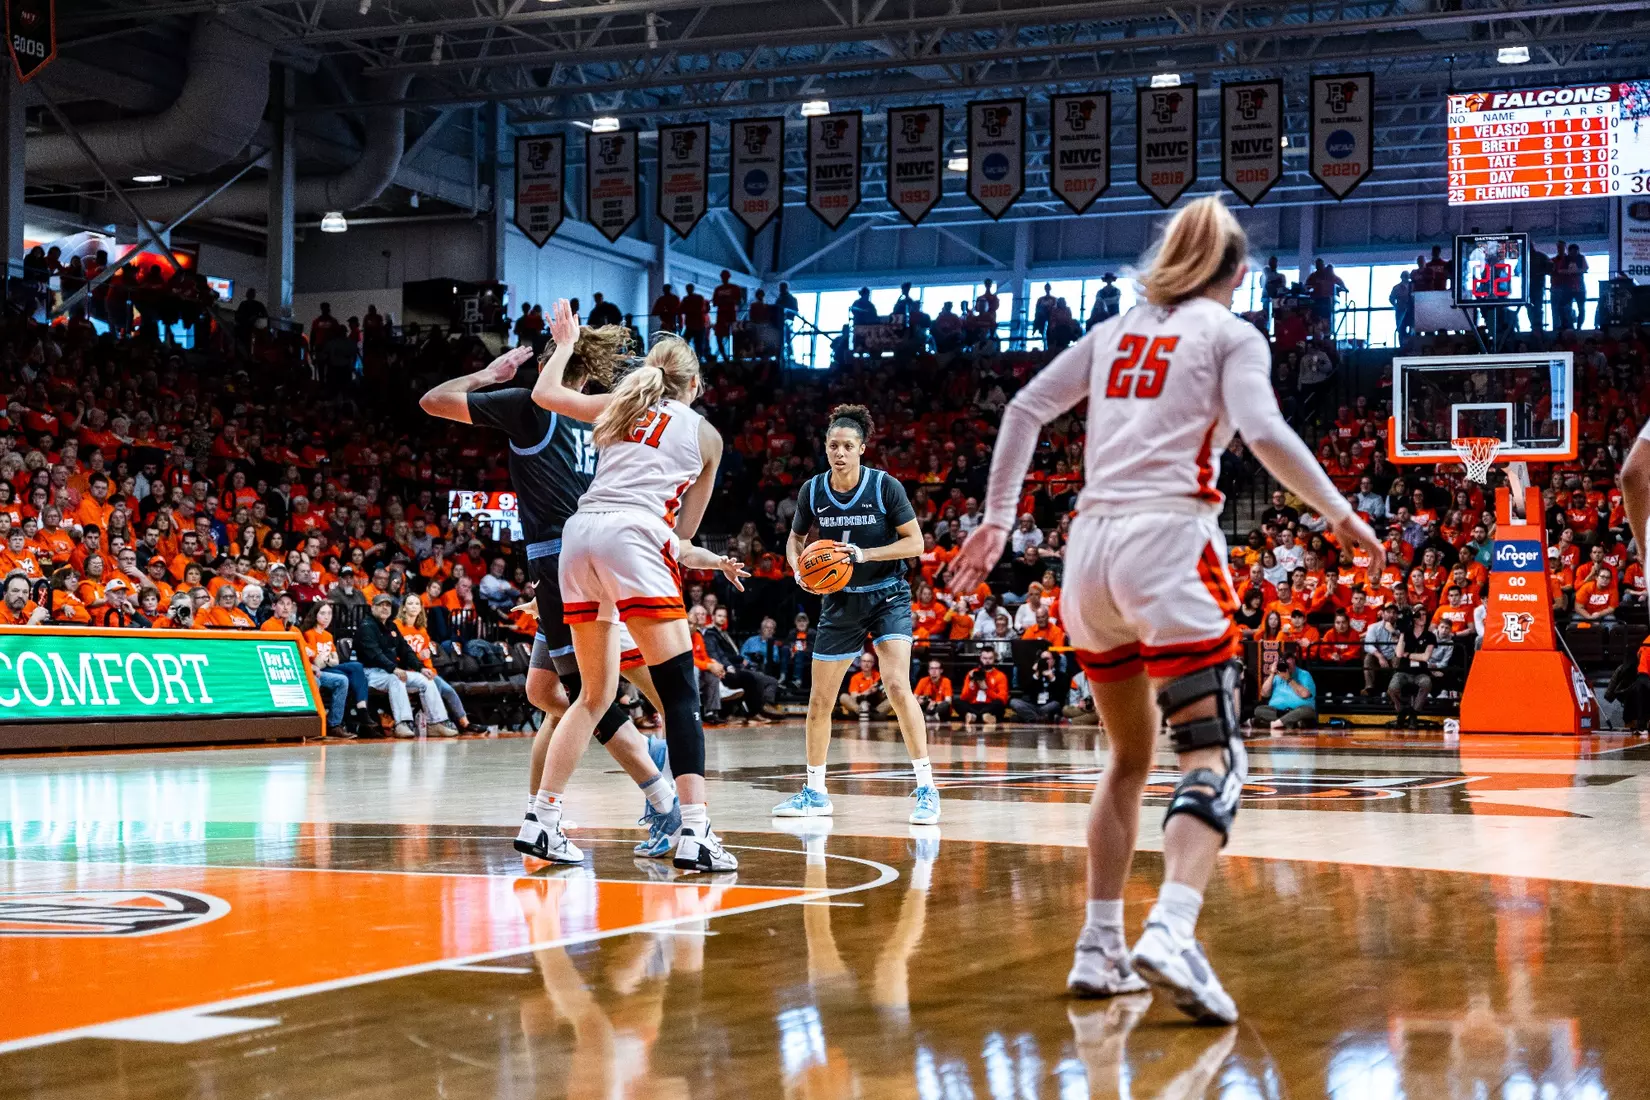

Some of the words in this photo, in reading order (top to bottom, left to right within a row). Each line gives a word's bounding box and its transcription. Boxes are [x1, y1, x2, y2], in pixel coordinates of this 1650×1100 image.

[14, 34, 44, 58] 2009
[1492, 86, 1612, 108] FALCONS
[1483, 112, 1516, 122] NAME
[1454, 127, 1460, 138] 1
[1474, 124, 1529, 138] VELASCO
[1542, 122, 1555, 133] 11
[1566, 120, 1572, 131] 1
[1582, 119, 1590, 130] 0
[1600, 117, 1606, 129] 1
[1612, 117, 1619, 127] 0
[1146, 141, 1188, 158] NIVC
[1231, 138, 1273, 155] NIVC
[1453, 144, 1461, 155] 5
[1482, 139, 1520, 153] BRETT
[1544, 138, 1553, 149] 8
[1564, 136, 1572, 147] 0
[1582, 135, 1590, 146] 2
[1600, 133, 1606, 145] 1
[1613, 133, 1618, 143] 1
[1060, 148, 1102, 164] NIVC
[1452, 159, 1465, 171] 11
[1488, 155, 1516, 168] TATE
[1544, 154, 1552, 165] 5
[1566, 152, 1572, 163] 1
[1583, 151, 1591, 161] 3
[1598, 149, 1606, 160] 0
[1611, 149, 1618, 160] 2
[896, 160, 935, 176] NIVC
[1236, 168, 1270, 184] 2019
[1322, 163, 1361, 177] 2020
[1451, 174, 1465, 185] 21
[1490, 171, 1514, 183] DAY
[1546, 169, 1552, 180] 1
[1564, 167, 1572, 178] 0
[1585, 166, 1591, 177] 1
[1598, 165, 1606, 176] 0
[1612, 165, 1619, 175] 0
[1064, 178, 1097, 193] 2017
[1151, 171, 1184, 186] 2018
[900, 190, 931, 204] 1993
[1450, 190, 1465, 201] 25
[1476, 186, 1530, 200] FLEMING
[1544, 184, 1552, 196] 7
[1564, 183, 1572, 194] 2
[1582, 182, 1591, 193] 4
[1600, 181, 1606, 192] 1
[1612, 180, 1619, 191] 0
[1472, 263, 1512, 297] 22
[1105, 333, 1180, 399] 25
[623, 409, 672, 448] 21
[818, 514, 876, 527] COLUMBIA
[804, 552, 832, 570] ELITE
[1496, 544, 1539, 568] Kroger
[1508, 576, 1526, 587] GO
[264, 652, 282, 668] Day
[282, 652, 291, 666] &
[0, 651, 214, 707] COMFORT
[268, 666, 298, 683] Night
